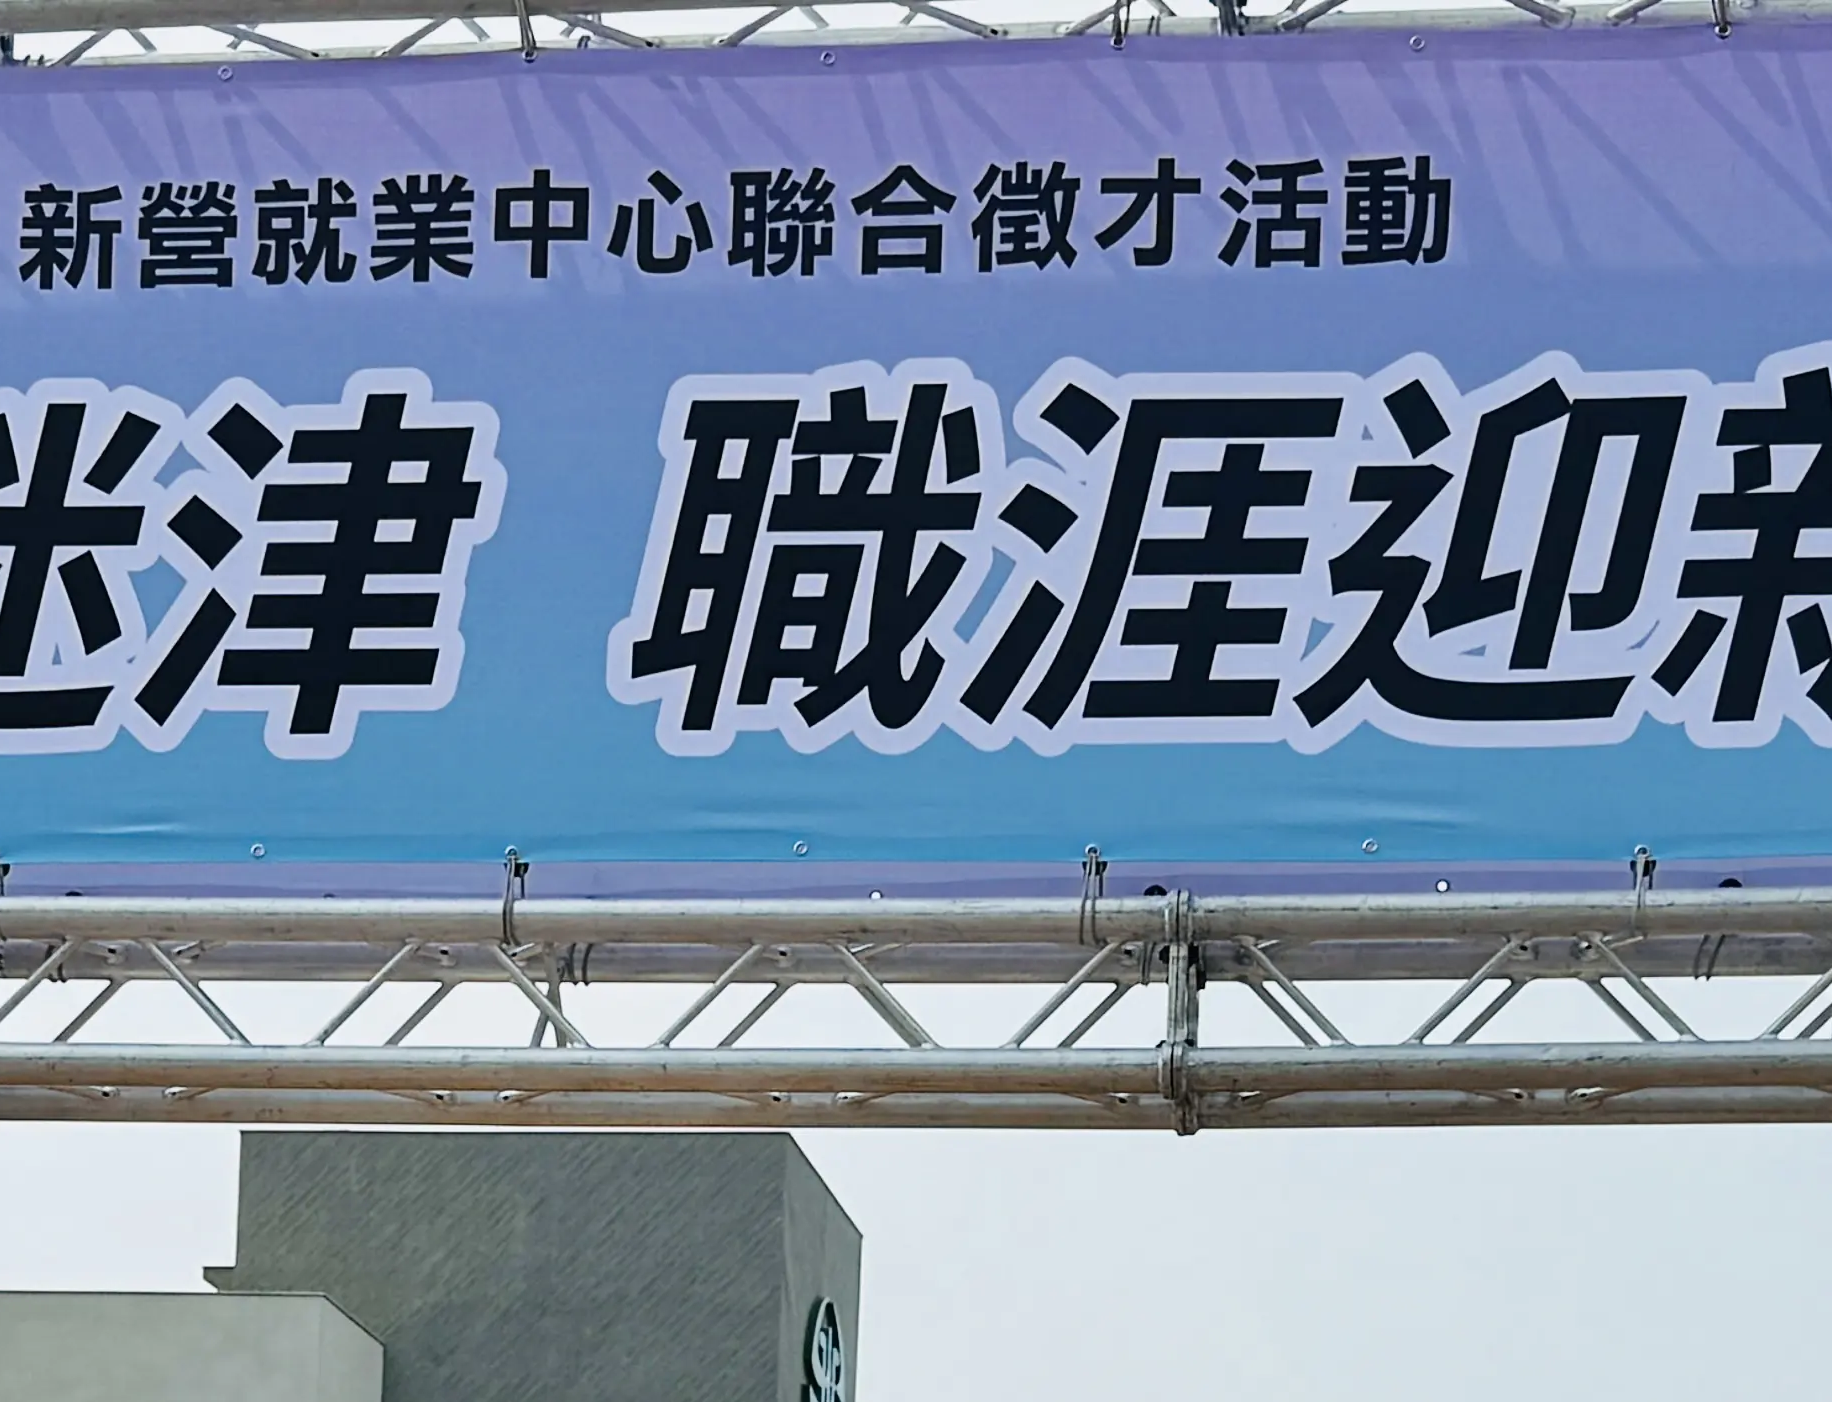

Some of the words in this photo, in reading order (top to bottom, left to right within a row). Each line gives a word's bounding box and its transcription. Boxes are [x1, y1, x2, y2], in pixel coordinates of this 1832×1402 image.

[17, 152, 1456, 294] 新營就業中心聯合徵才活動
